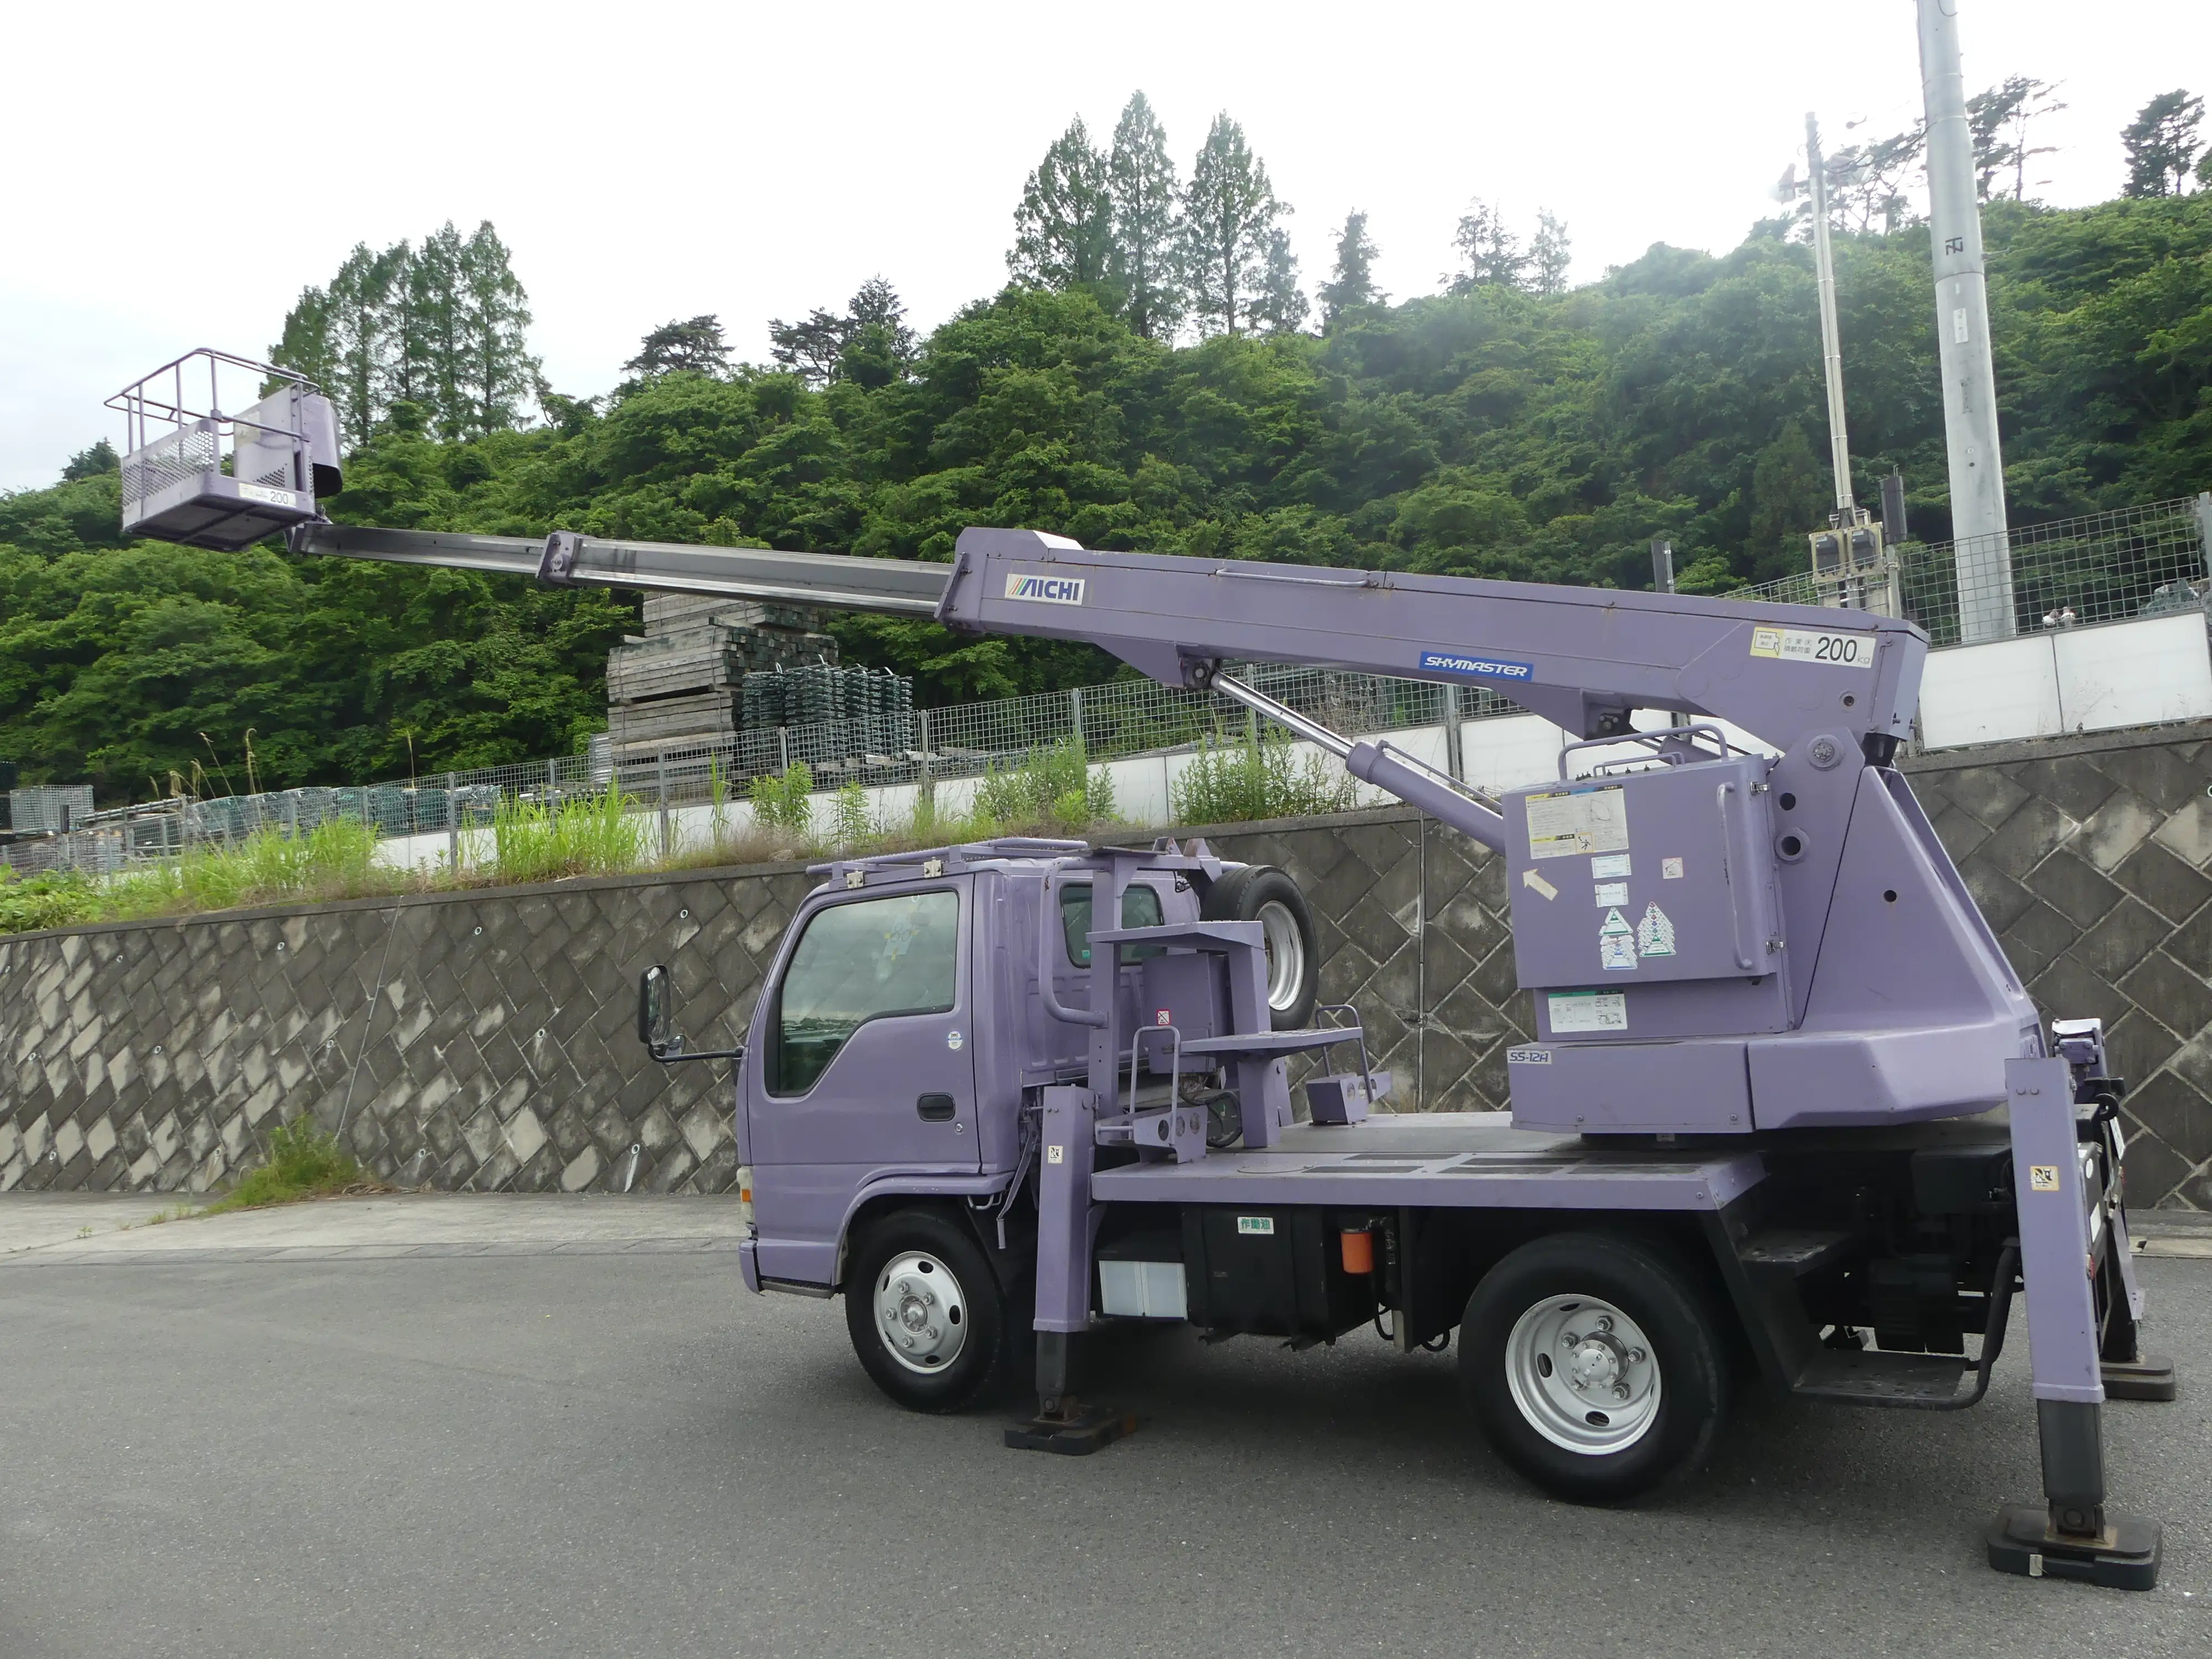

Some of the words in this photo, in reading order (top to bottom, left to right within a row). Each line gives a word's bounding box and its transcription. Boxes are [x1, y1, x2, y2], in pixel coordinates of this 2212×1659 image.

[270, 491, 289, 504] 200
[1019, 578, 1080, 601] AICHI
[1815, 637, 1857, 662] 200
[1857, 655, 1870, 664] kg
[1425, 656, 1527, 676] SKYMASTER
[1510, 1052, 1548, 1062] SS-12H
